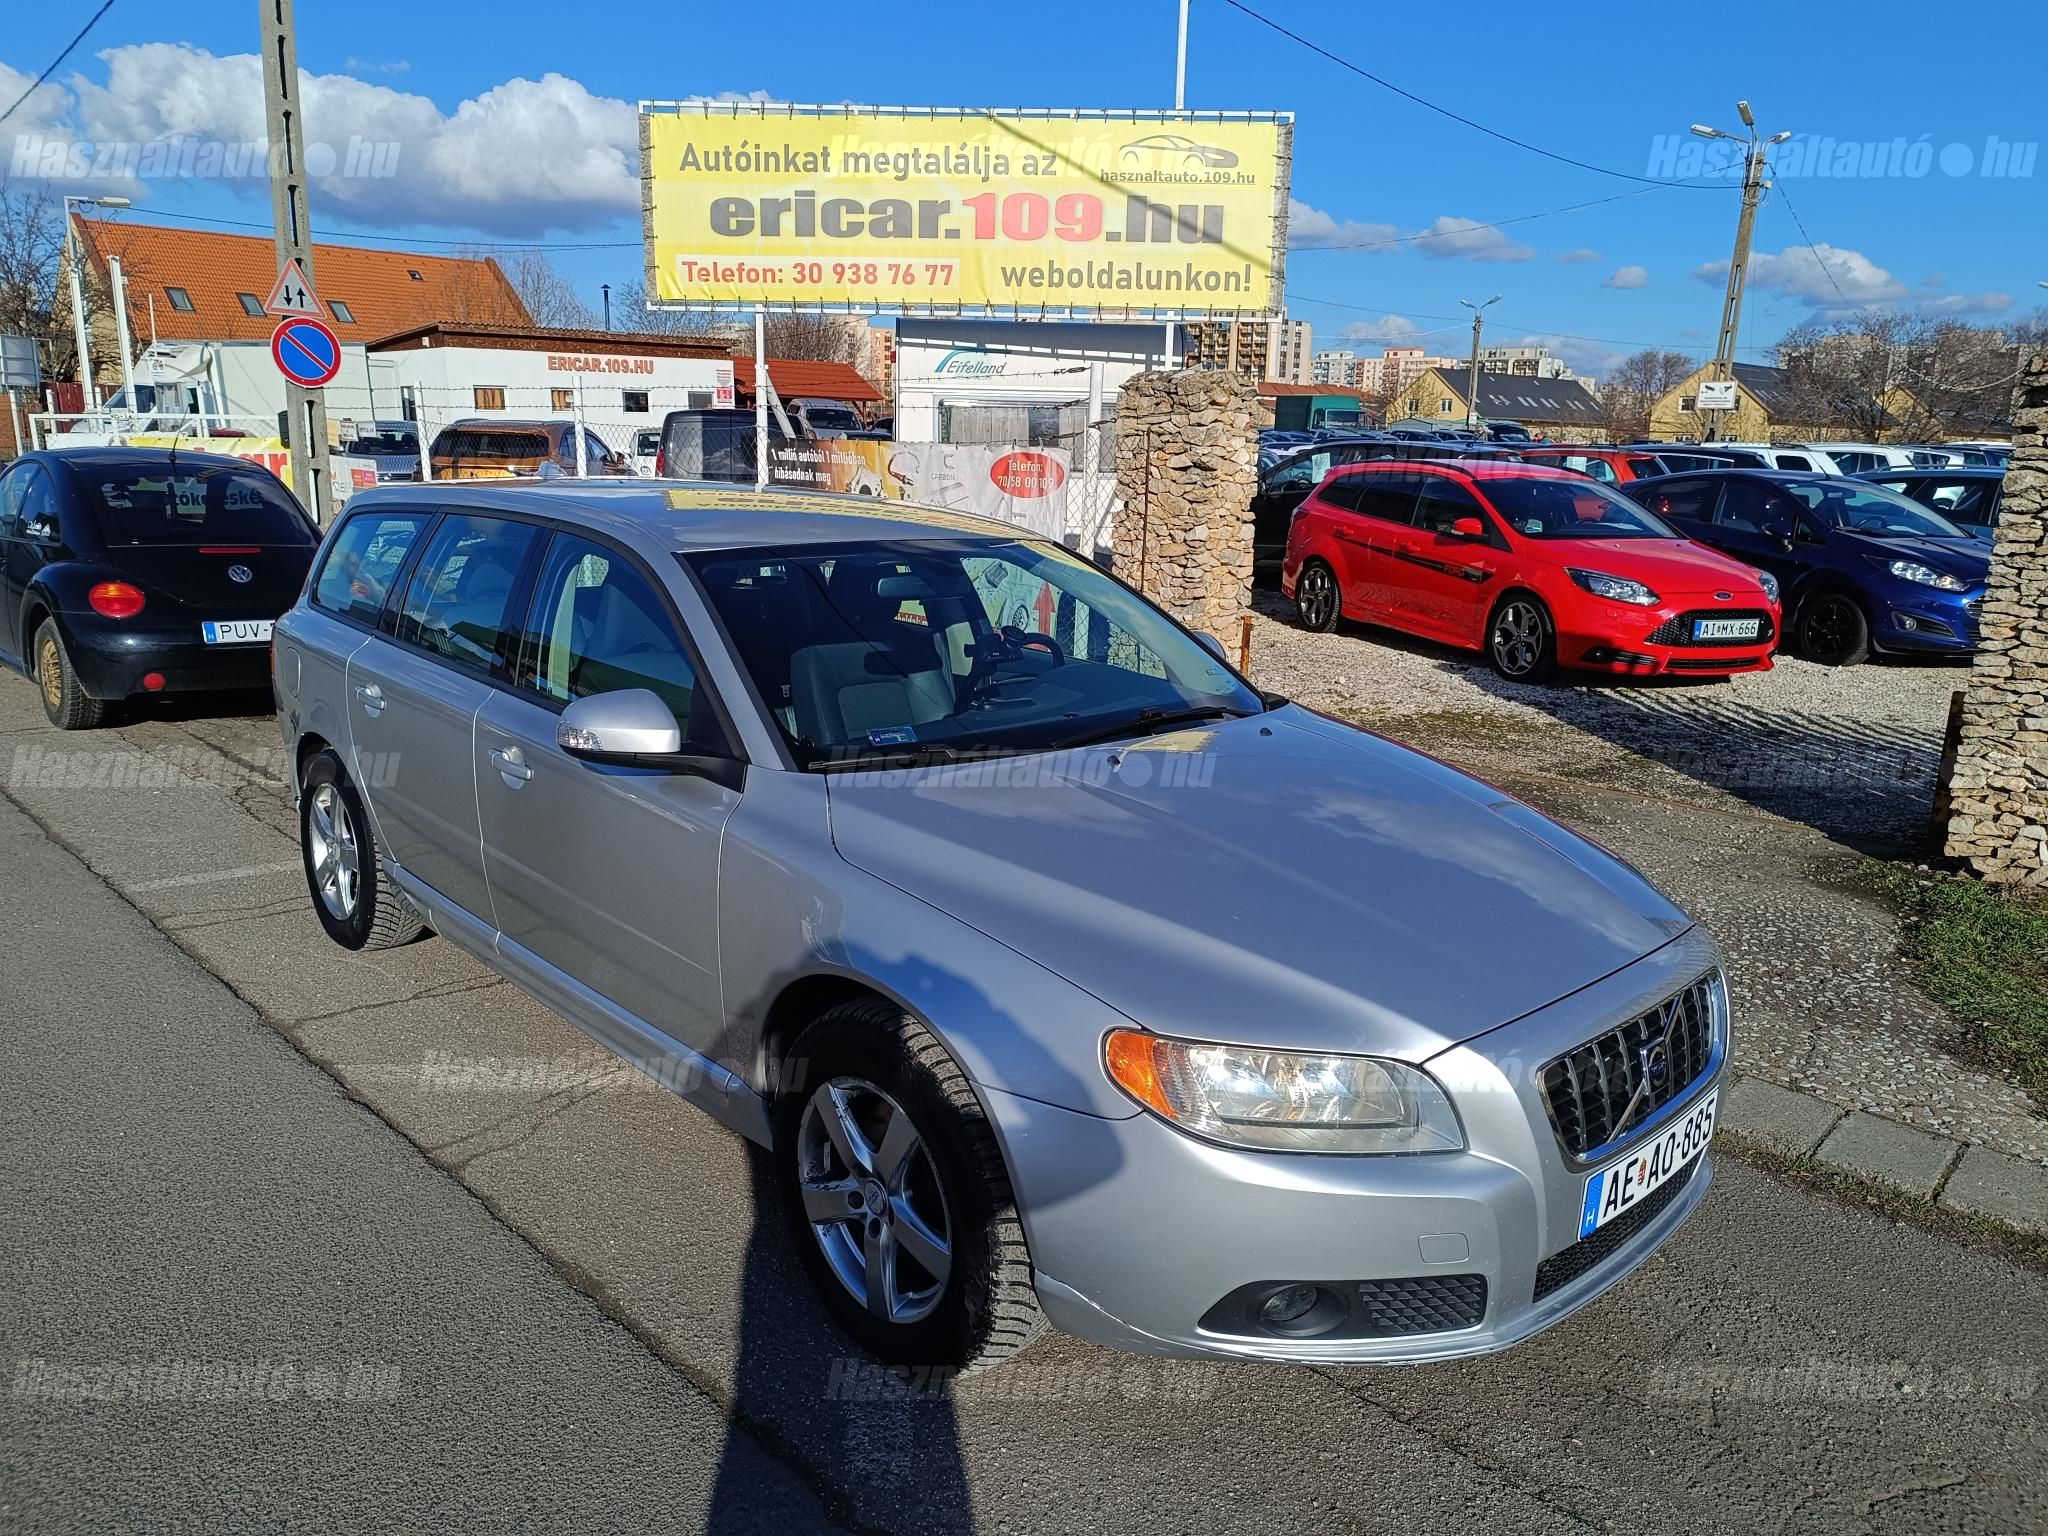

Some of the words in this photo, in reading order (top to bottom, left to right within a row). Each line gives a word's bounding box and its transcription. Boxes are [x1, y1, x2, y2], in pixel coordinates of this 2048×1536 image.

[679, 139, 831, 173] Autóinkat
[843, 142, 1010, 182] megtalálja
[1022, 154, 1057, 176] az
[1101, 169, 1255, 185] hasznaltauto.109.hu
[710, 190, 1224, 244] ericar.109.hu
[682, 261, 783, 284] Telefon:
[792, 262, 823, 284] 30
[832, 262, 878, 284] 938
[888, 263, 915, 285] 76
[925, 264, 953, 286] 77
[1001, 259, 1251, 292] weboldalunkon!
[547, 355, 654, 375] ERICAR.109.HU
[946, 360, 1007, 374] Eifelland
[778, 448, 798, 461] millió
[798, 449, 825, 463] autóból
[831, 450, 866, 465] millióban
[1007, 459, 1043, 473] Telefon:
[774, 466, 814, 481] hibásodnak
[815, 471, 832, 485] meg
[930, 472, 956, 481] CARBON
[997, 475, 1021, 489] 70/58
[220, 623, 273, 640] PUV-
[1702, 623, 1715, 636] AI
[1721, 621, 1756, 636] MX-666
[1603, 1157, 1639, 1218] AE
